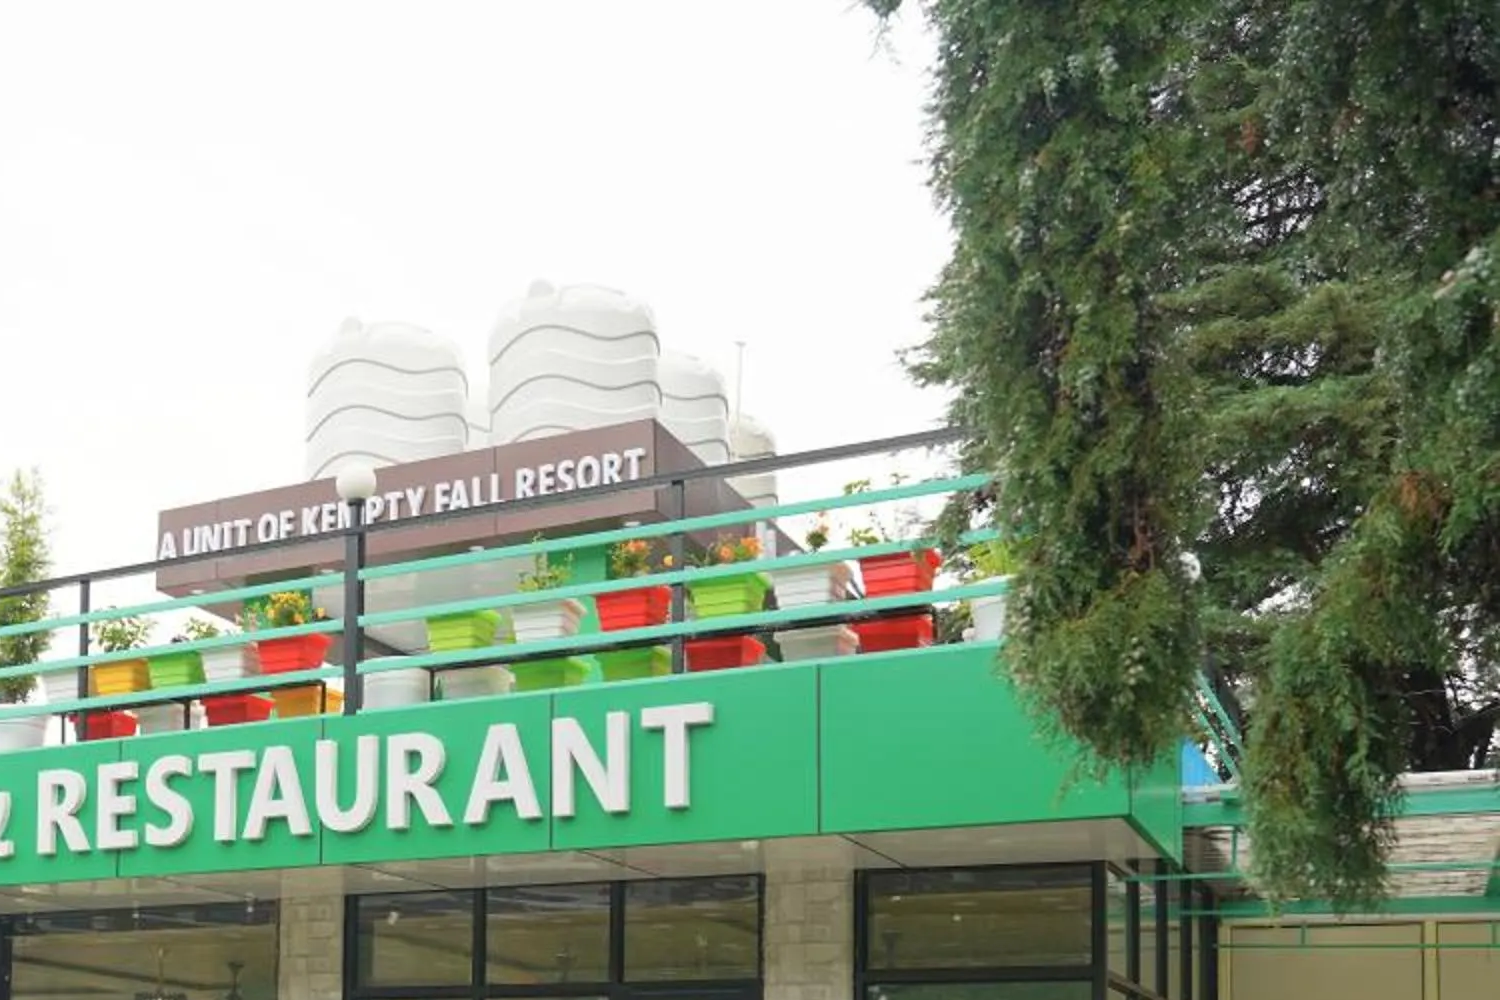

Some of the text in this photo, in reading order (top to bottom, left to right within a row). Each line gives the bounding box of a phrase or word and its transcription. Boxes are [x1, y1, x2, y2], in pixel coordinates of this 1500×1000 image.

[158, 530, 178, 560] A
[183, 518, 252, 557] UNIT
[257, 510, 296, 543] OF
[434, 473, 506, 513] FALL
[515, 447, 647, 499] RESORT
[36, 702, 715, 857] RESTAURANT
